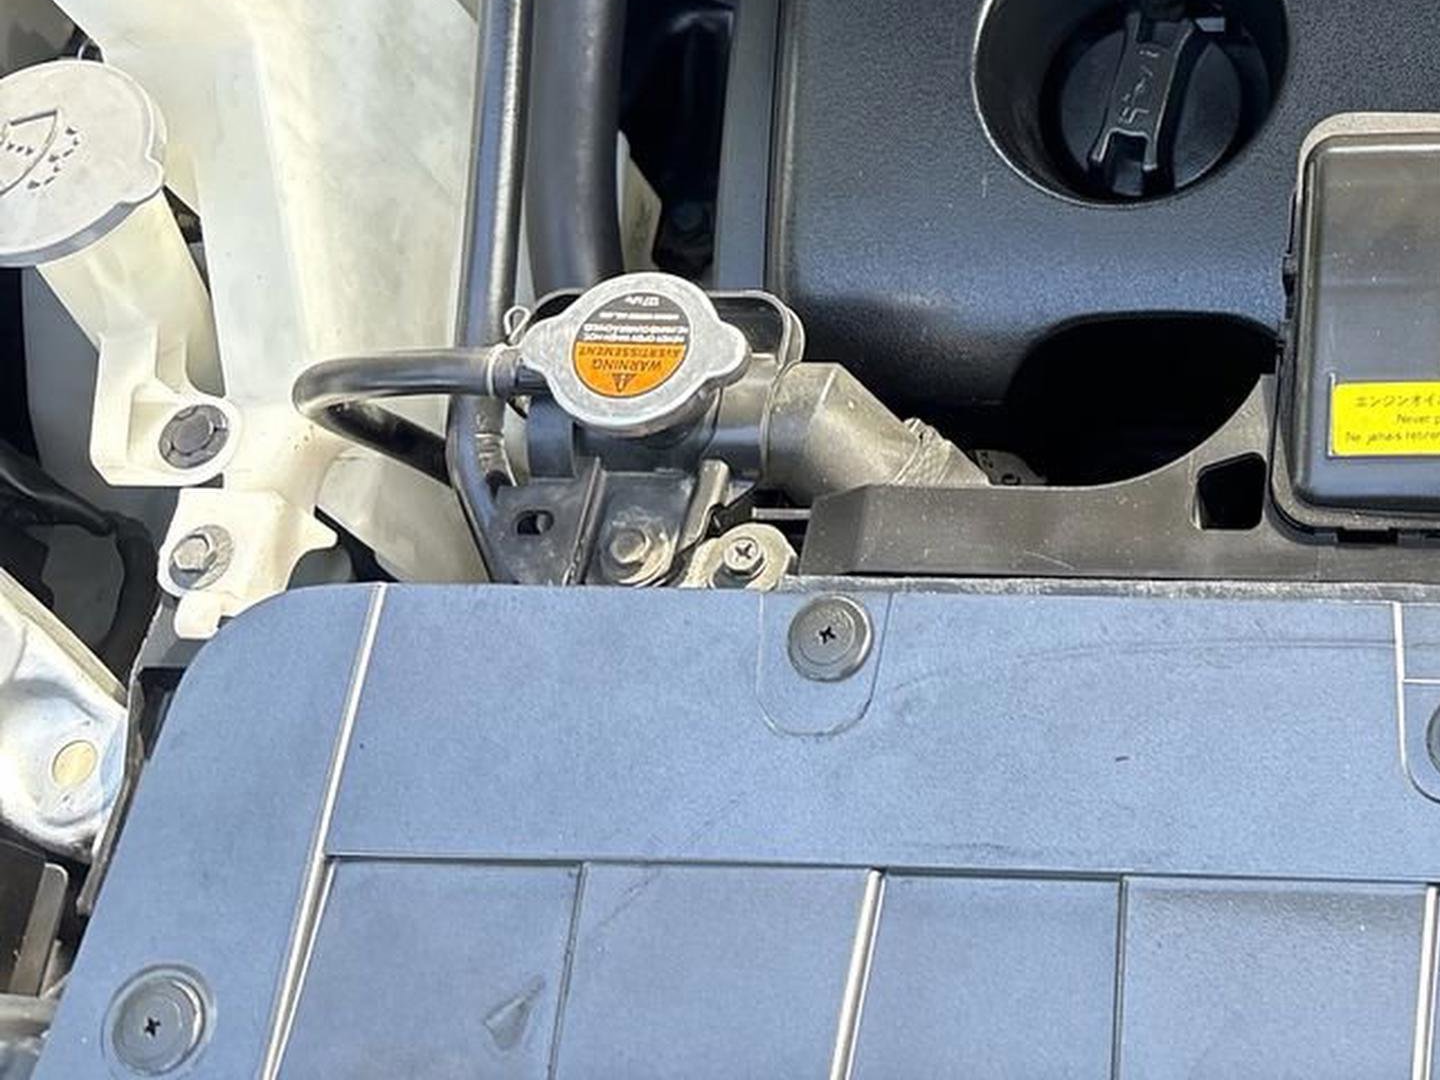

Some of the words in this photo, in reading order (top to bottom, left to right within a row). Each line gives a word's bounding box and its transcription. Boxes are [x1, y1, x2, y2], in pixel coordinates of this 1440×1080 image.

[578, 346, 682, 357] AVERTISSEMENT
[592, 358, 662, 372] WARNING
[1396, 414, 1431, 424] Never
